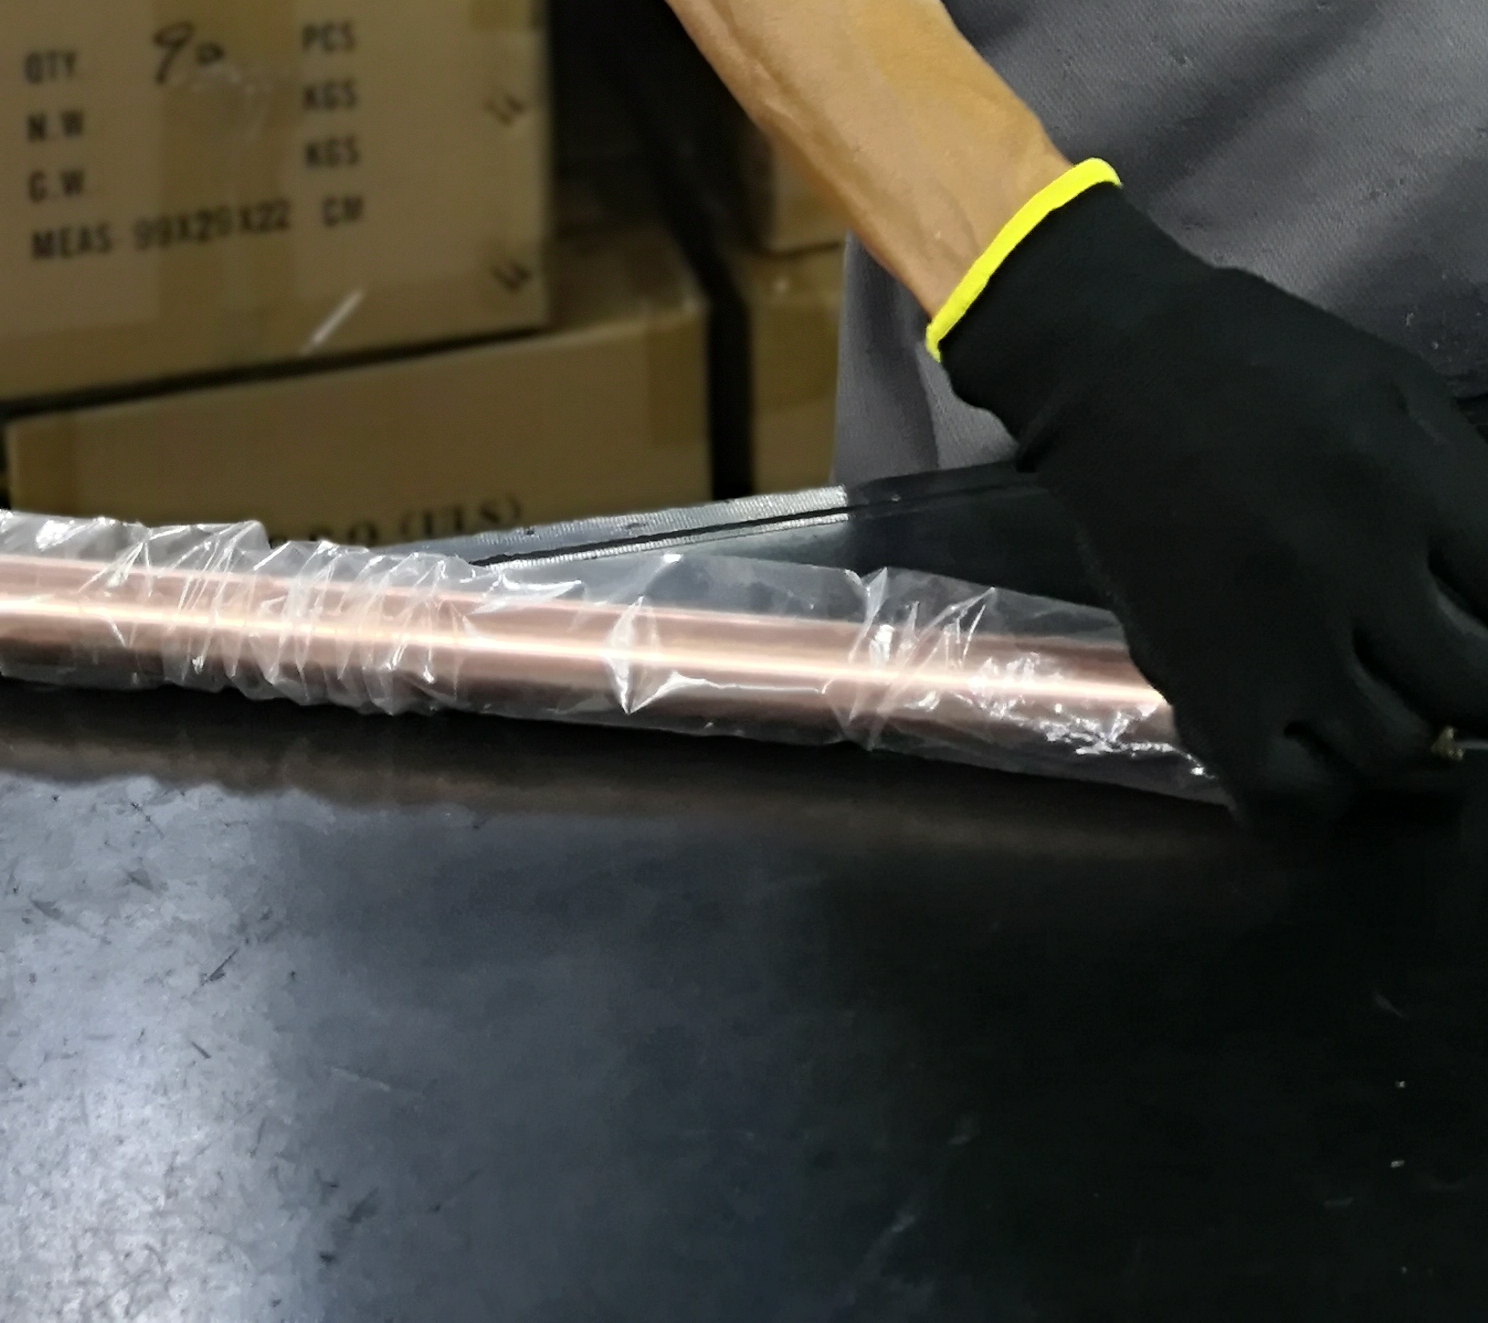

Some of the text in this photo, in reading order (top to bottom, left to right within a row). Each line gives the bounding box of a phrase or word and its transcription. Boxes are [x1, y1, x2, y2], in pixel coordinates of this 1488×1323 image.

[302, 22, 355, 52] PCS
[303, 79, 358, 110] KGS
[305, 137, 359, 169] KGS
[31, 223, 111, 260] MEAS
